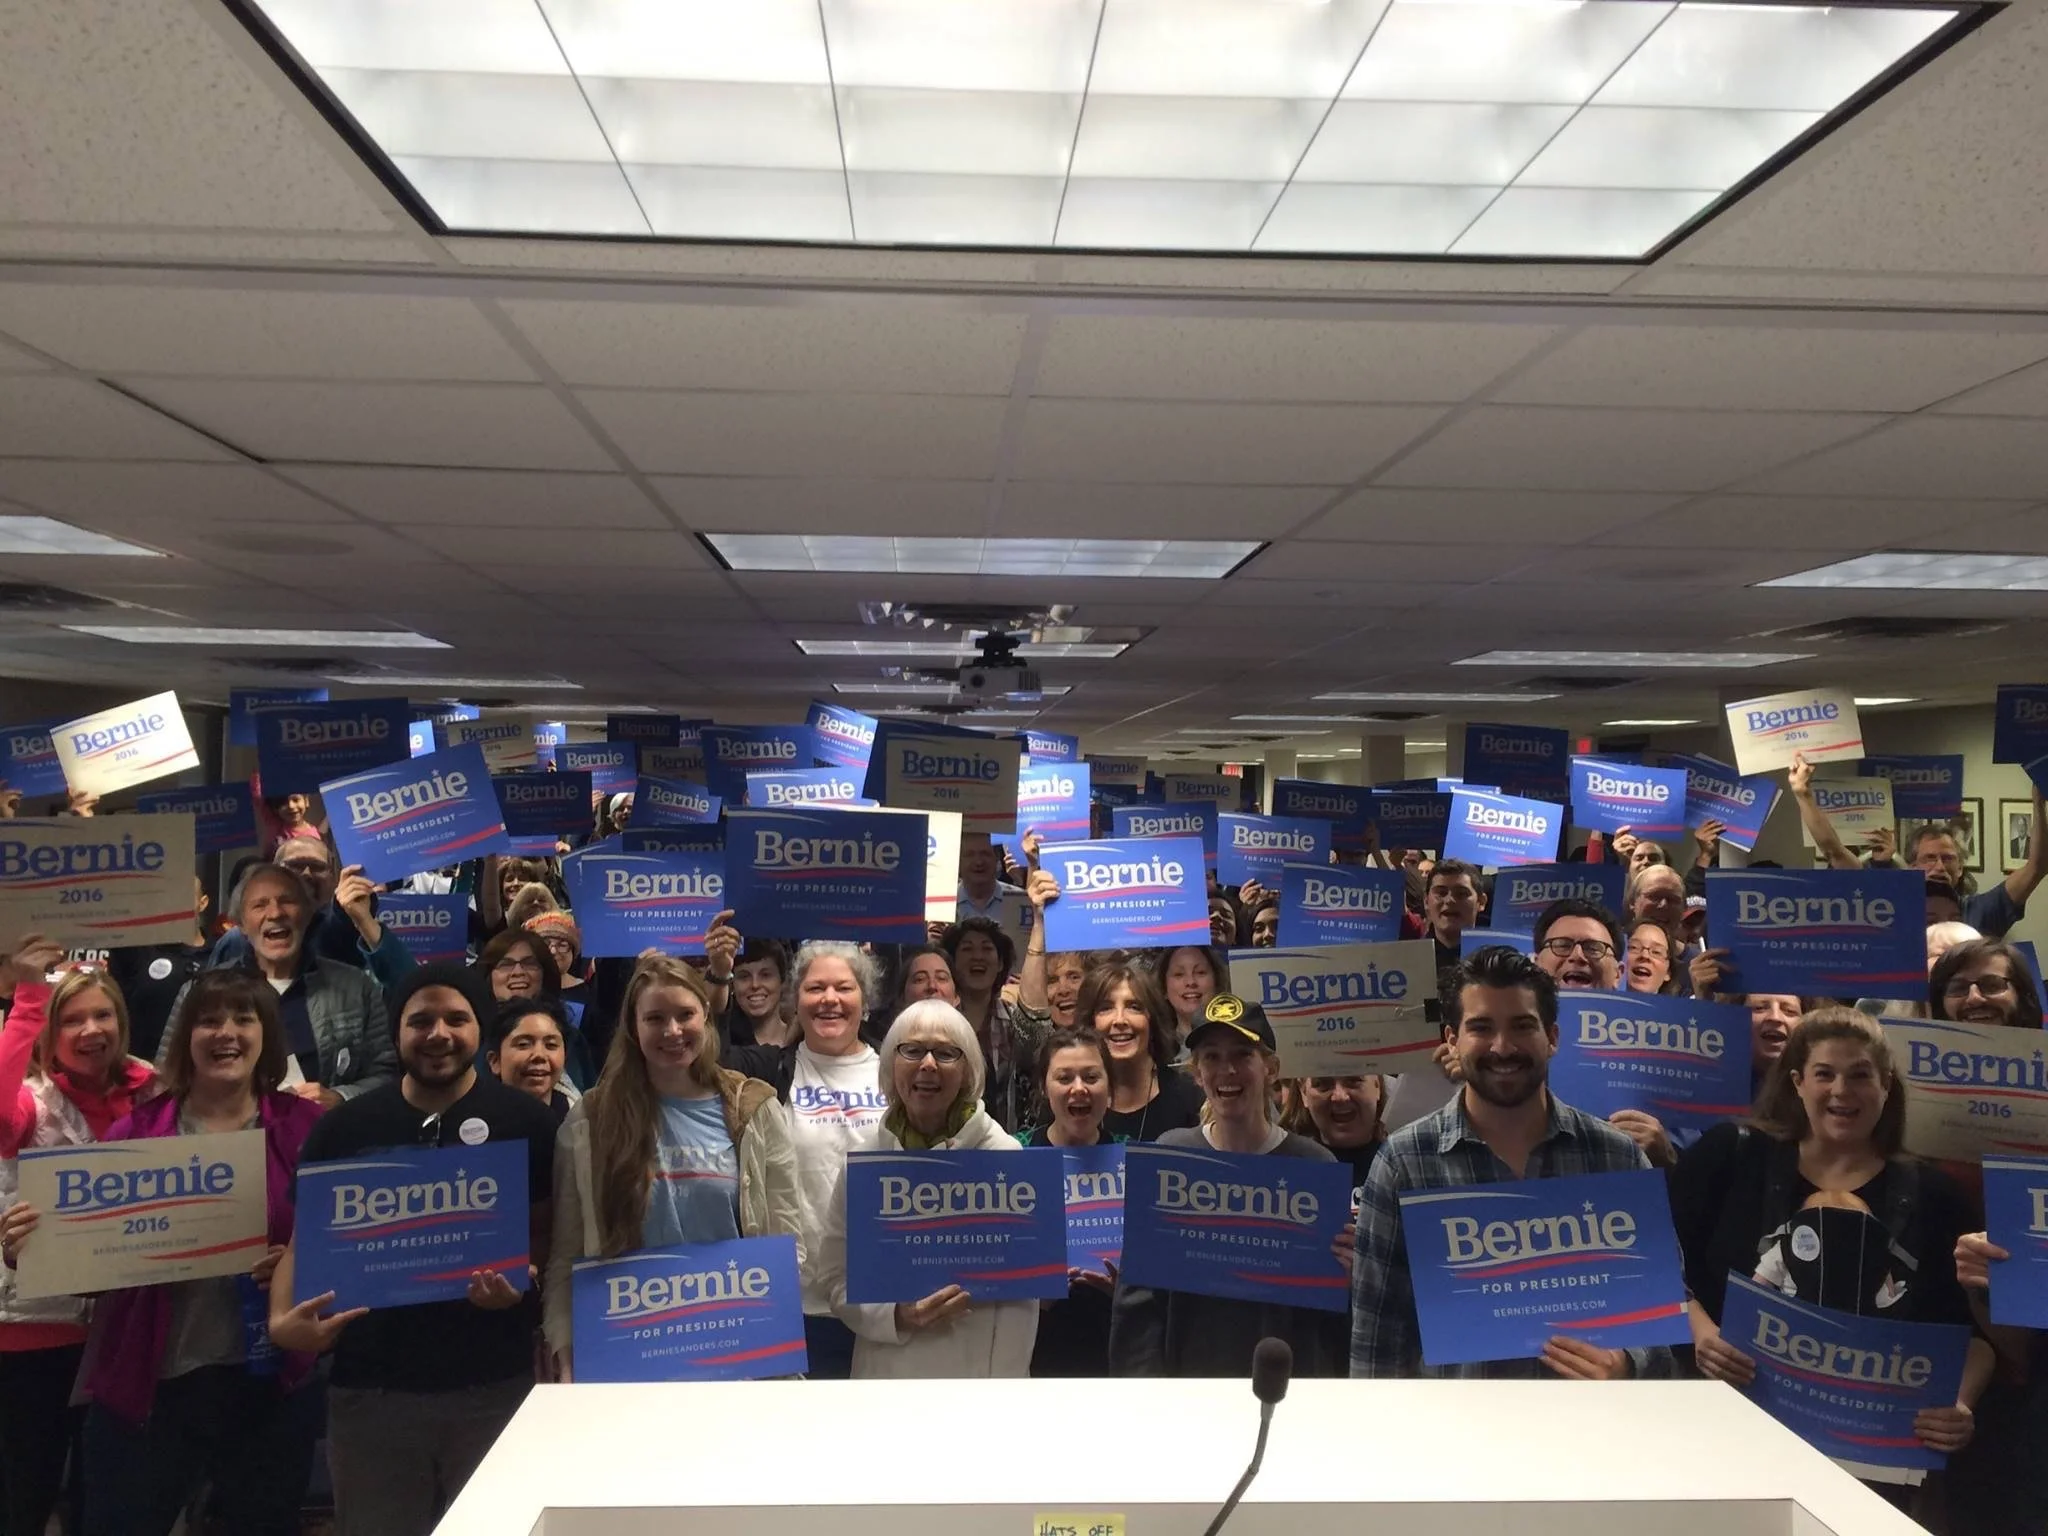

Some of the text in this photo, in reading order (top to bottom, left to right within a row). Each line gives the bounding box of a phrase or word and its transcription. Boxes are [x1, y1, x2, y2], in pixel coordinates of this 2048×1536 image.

[278, 713, 390, 743] Bernie
[817, 712, 875, 743] Bernie
[1746, 700, 1839, 732] Bernie
[10, 735, 53, 758] Ber
[71, 713, 165, 754] Bernie
[1480, 734, 1554, 757] Bernie
[1784, 731, 1809, 741] 2016
[113, 747, 139, 761] 2016
[566, 749, 625, 768] Bernie
[715, 736, 797, 760] Bernie
[902, 751, 1000, 780] Bernie
[346, 769, 468, 825] Bernie
[505, 781, 579, 800] Bernie
[649, 784, 710, 813] Bernie
[766, 778, 855, 804] Bernie
[933, 787, 960, 799] 2016
[1176, 780, 1230, 797] Bernie
[1586, 772, 1670, 800] Bernie
[1814, 787, 1886, 808] Bernie
[1287, 791, 1358, 814] Bernie
[1379, 800, 1445, 819] Bernie
[376, 813, 456, 841] FOR PRESIDENT
[1128, 812, 1204, 836] Bernie
[1466, 802, 1547, 834] Bernie
[754, 830, 901, 870] Bernie
[1233, 825, 1316, 852] Bernie
[0, 832, 165, 877] Bernie
[604, 867, 723, 898] Bernie
[1064, 854, 1184, 889] Bernie
[58, 887, 103, 905] 2016
[776, 882, 875, 894] FOR PRESIDENT
[1302, 879, 1392, 913] Bernie
[1510, 876, 1604, 901] Bernie
[624, 910, 704, 918] FOR PRESIDENT
[1086, 899, 1166, 910] FOR PRESIDENT
[1736, 888, 1895, 928] Bernie
[1762, 940, 1869, 952] FOR PRESIDENT
[1258, 961, 1408, 1004] Bernie
[1316, 1016, 1356, 1032] 2016
[1577, 1010, 1725, 1058] Bernie
[1601, 1061, 1700, 1081] FOR PRESIDENT
[1908, 1040, 2048, 1091] Berni
[1968, 1100, 2012, 1118] 2016
[54, 1153, 235, 1209] Bernie
[879, 1170, 1037, 1216] Bernie
[331, 1167, 498, 1225] Bernie
[1156, 1169, 1319, 1225] Bernie
[123, 1215, 170, 1235] 2016
[1441, 1200, 1637, 1263] Bernie
[358, 1231, 471, 1252] FOR PRESIDENT
[905, 1234, 1012, 1245] FOR PRESIDENT
[1180, 1228, 1290, 1250] FOR PRESIDENT
[605, 1258, 770, 1316] Bernie
[1482, 1274, 1612, 1294] FOR PRESIDENT
[633, 1317, 745, 1340] FOR PRESIDENT
[1752, 1309, 1933, 1389] Bernie
[1774, 1374, 1897, 1413] FOR PRESIDENT
